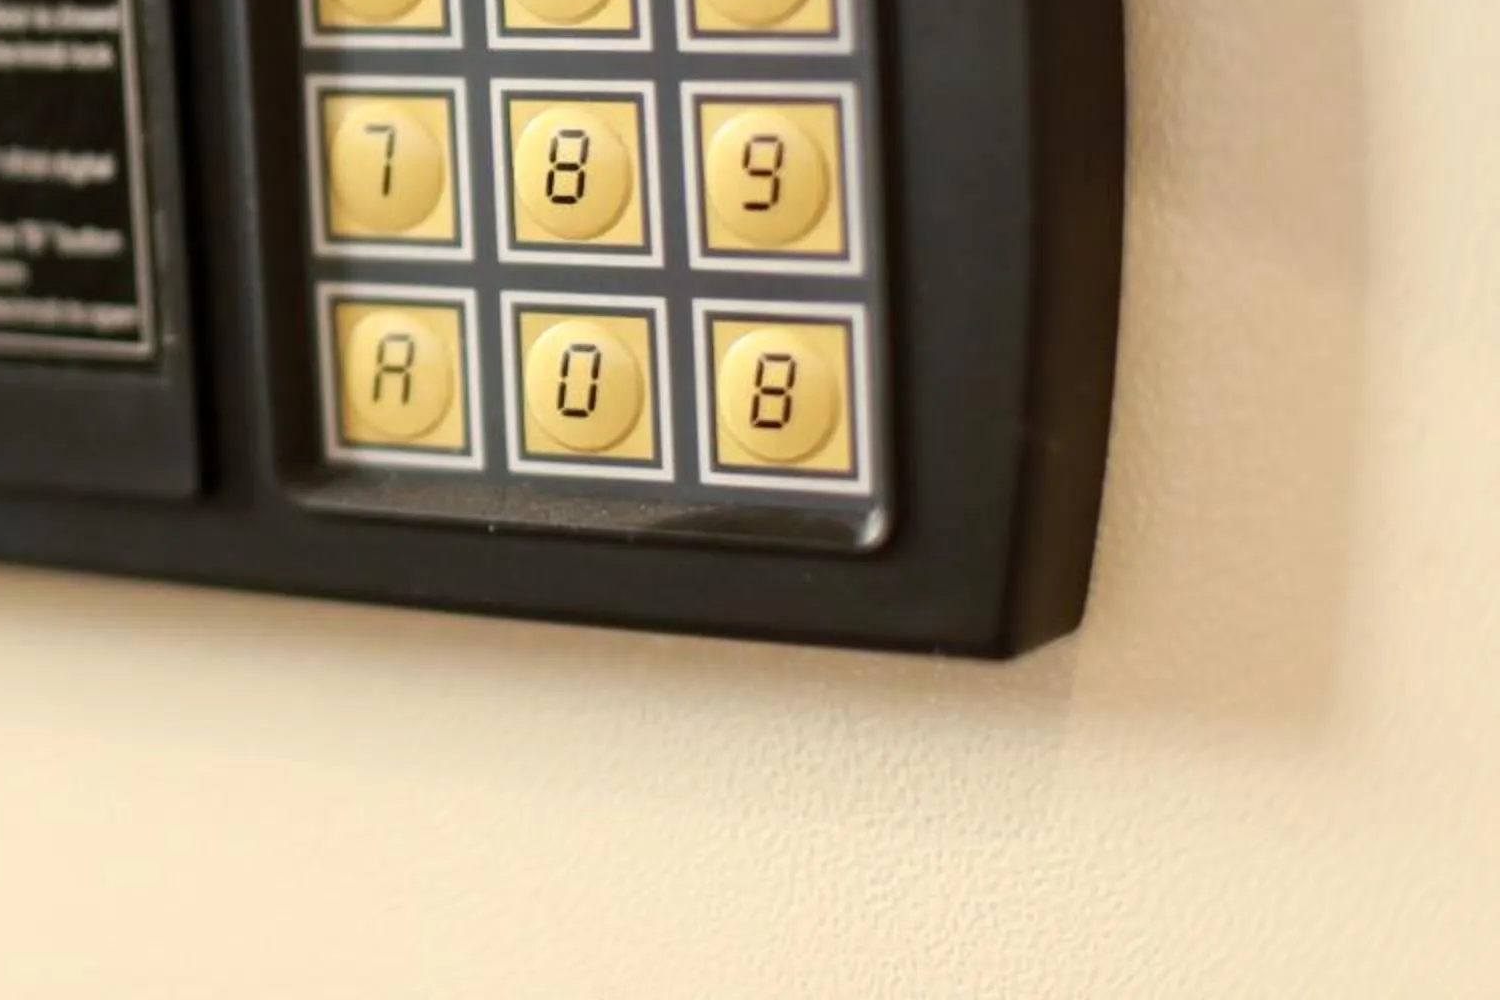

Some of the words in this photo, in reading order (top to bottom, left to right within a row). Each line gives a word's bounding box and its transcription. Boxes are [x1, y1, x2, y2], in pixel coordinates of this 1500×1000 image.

[364, 123, 397, 199] 7
[545, 128, 590, 205] 8
[741, 133, 785, 212] 9
[371, 332, 415, 407] A
[556, 342, 602, 418] 0
